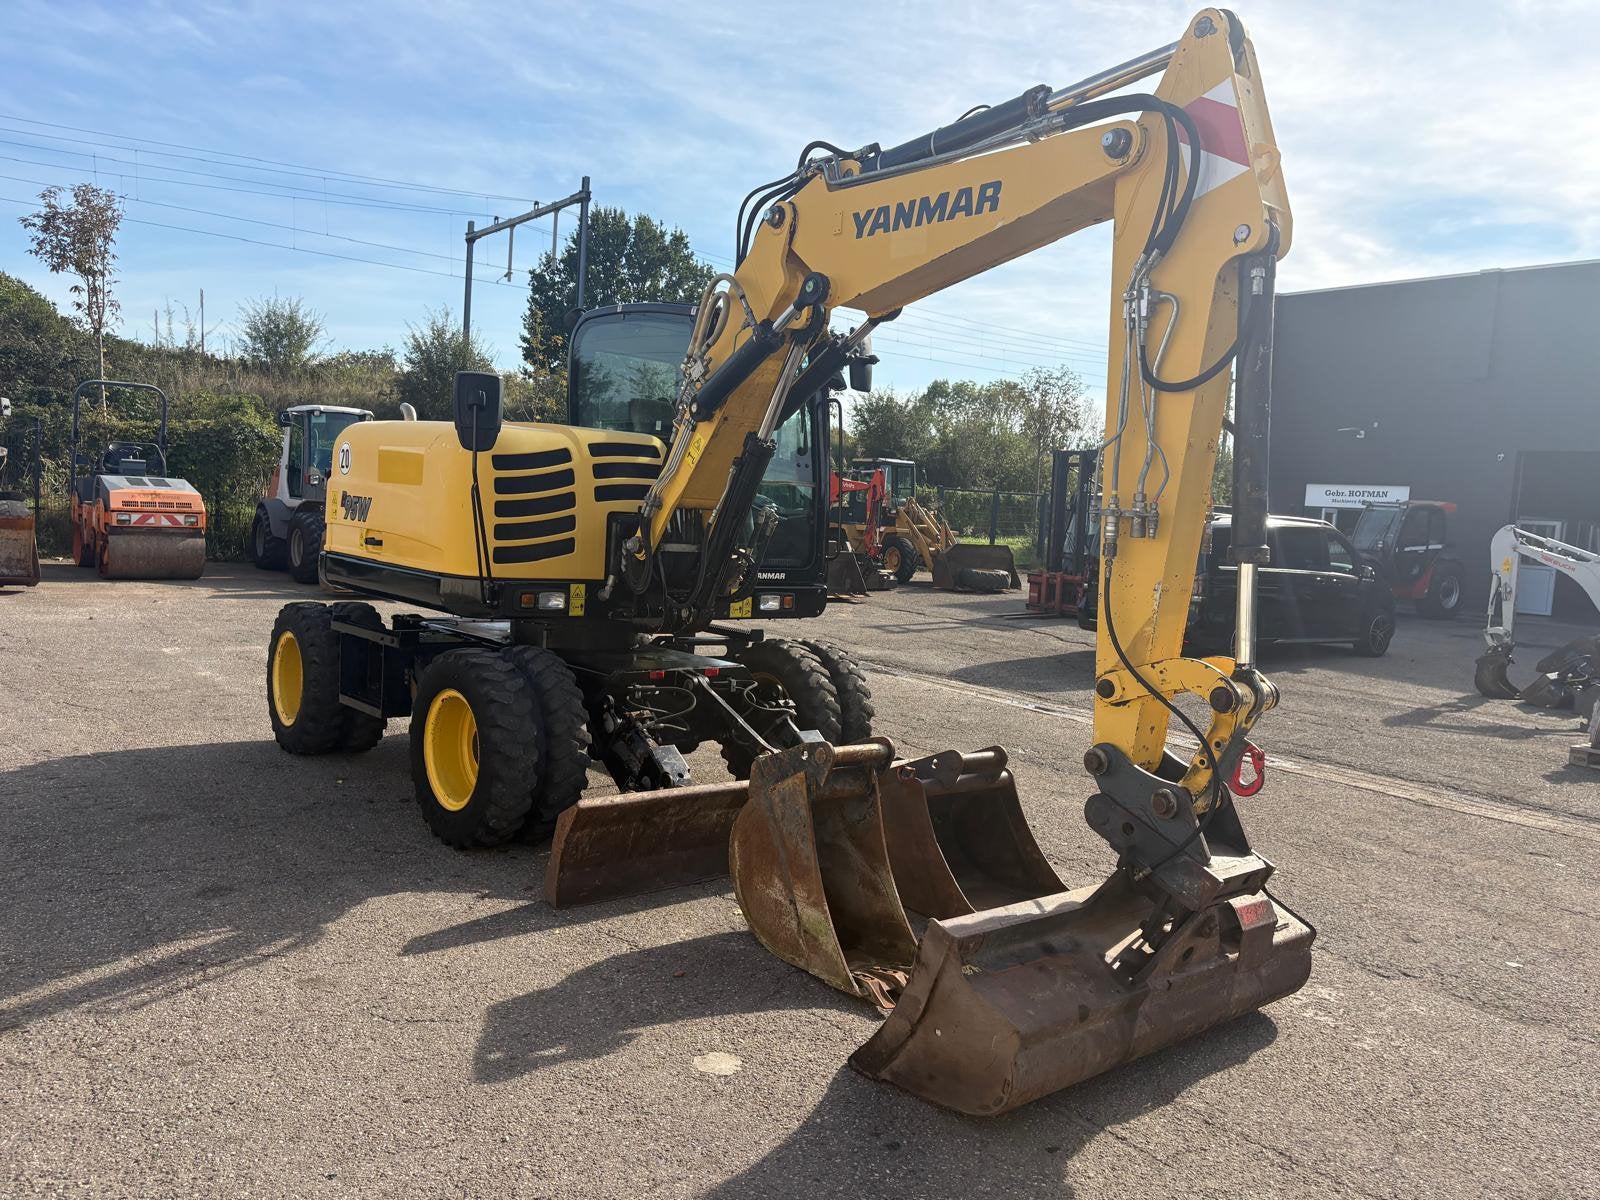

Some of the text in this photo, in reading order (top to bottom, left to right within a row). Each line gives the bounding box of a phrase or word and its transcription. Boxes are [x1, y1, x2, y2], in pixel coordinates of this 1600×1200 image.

[852, 180, 1003, 240] YANMAR
[340, 448, 350, 469] 20
[1324, 489, 1388, 498] Gebr. HOFMAN
[757, 572, 786, 580] ANMAR
